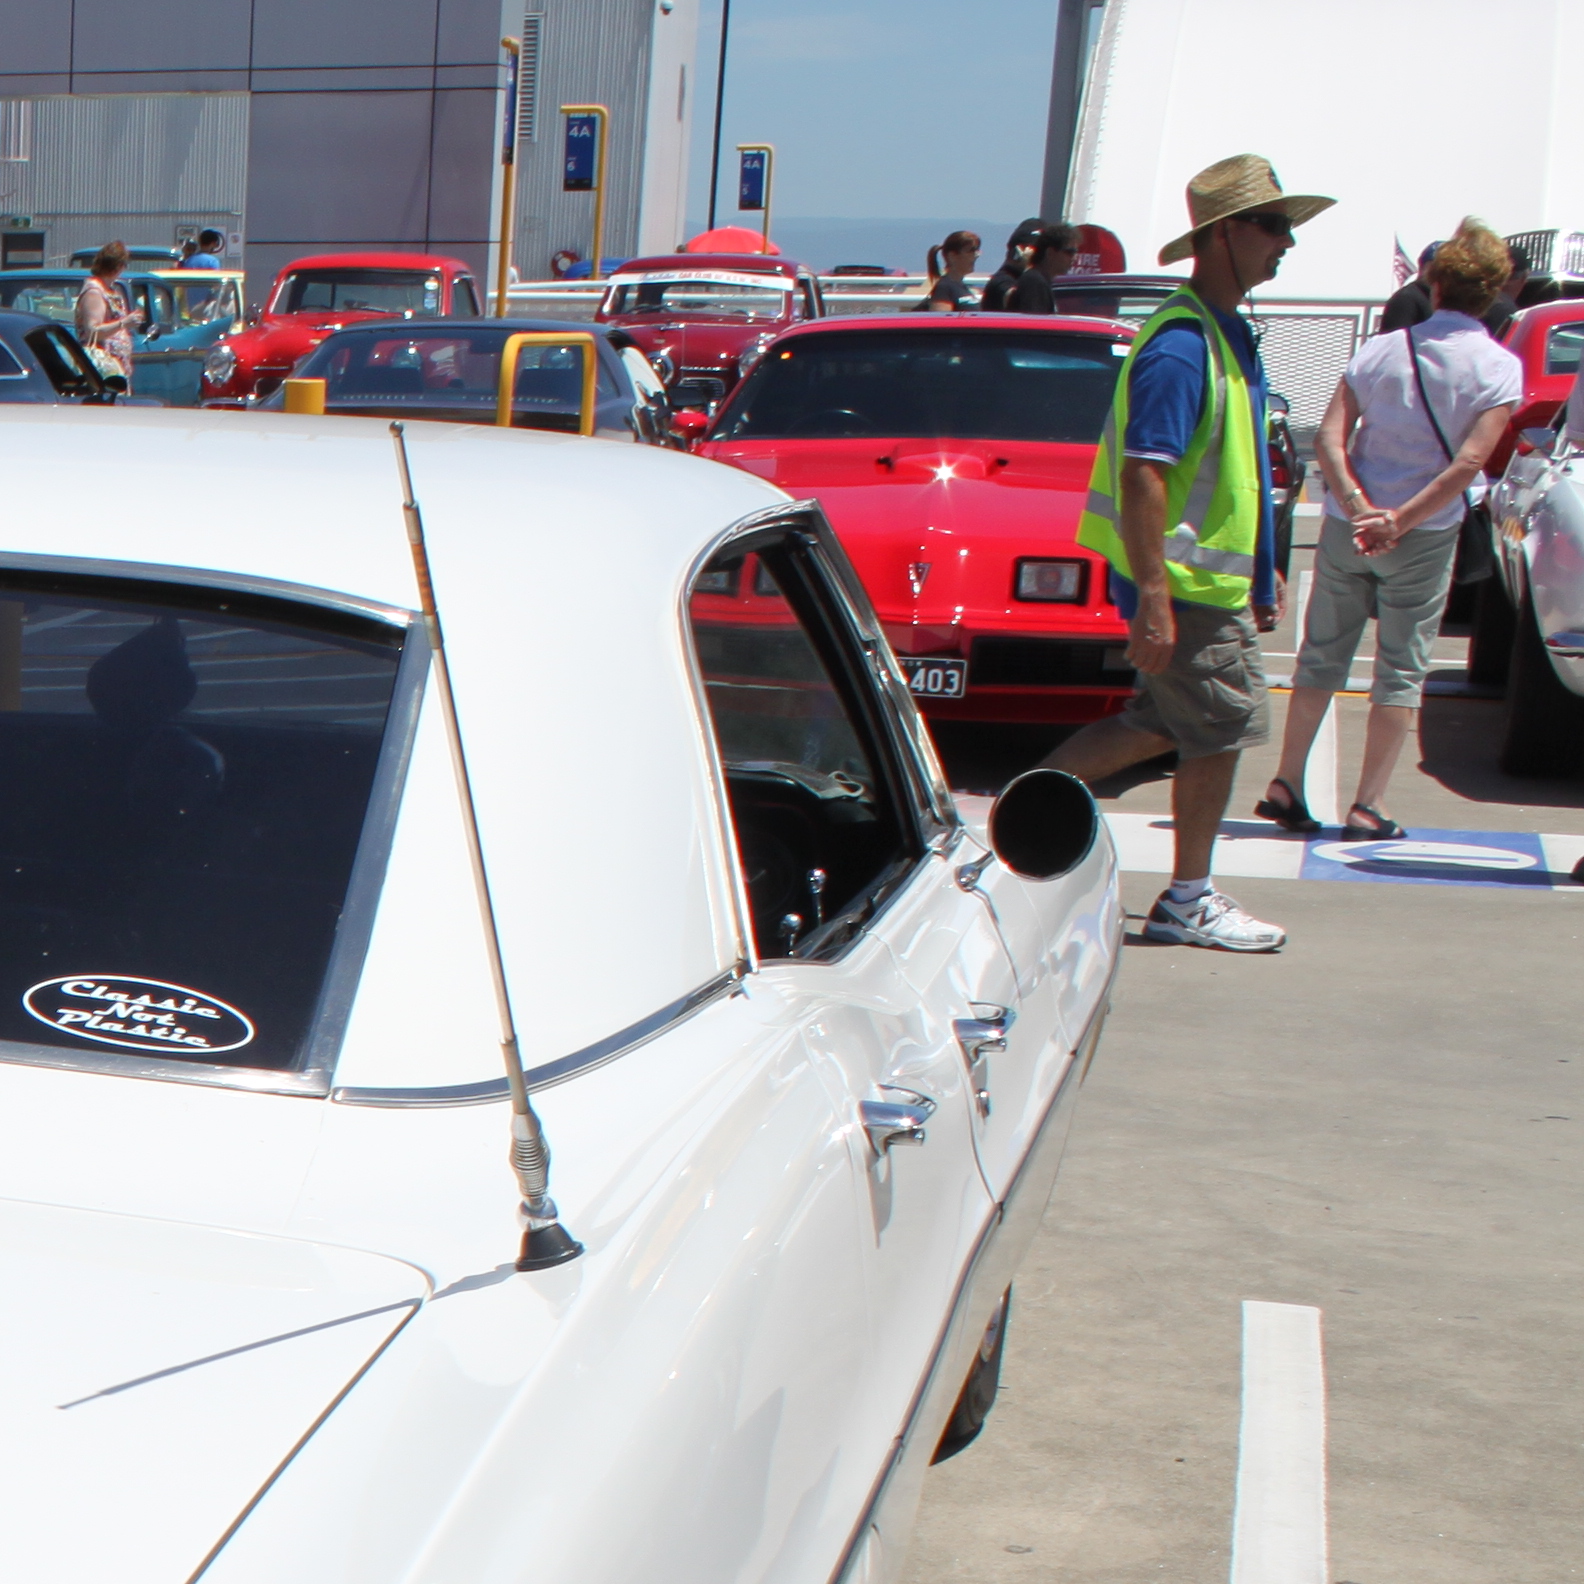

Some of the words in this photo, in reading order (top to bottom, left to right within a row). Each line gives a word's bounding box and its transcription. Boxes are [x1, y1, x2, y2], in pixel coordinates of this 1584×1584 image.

[568, 125, 590, 138] 4A
[743, 160, 761, 170] 4A
[910, 667, 961, 693] 403
[61, 980, 221, 1019] Classic
[93, 1002, 176, 1027] Not
[56, 1008, 211, 1048] Plastic
